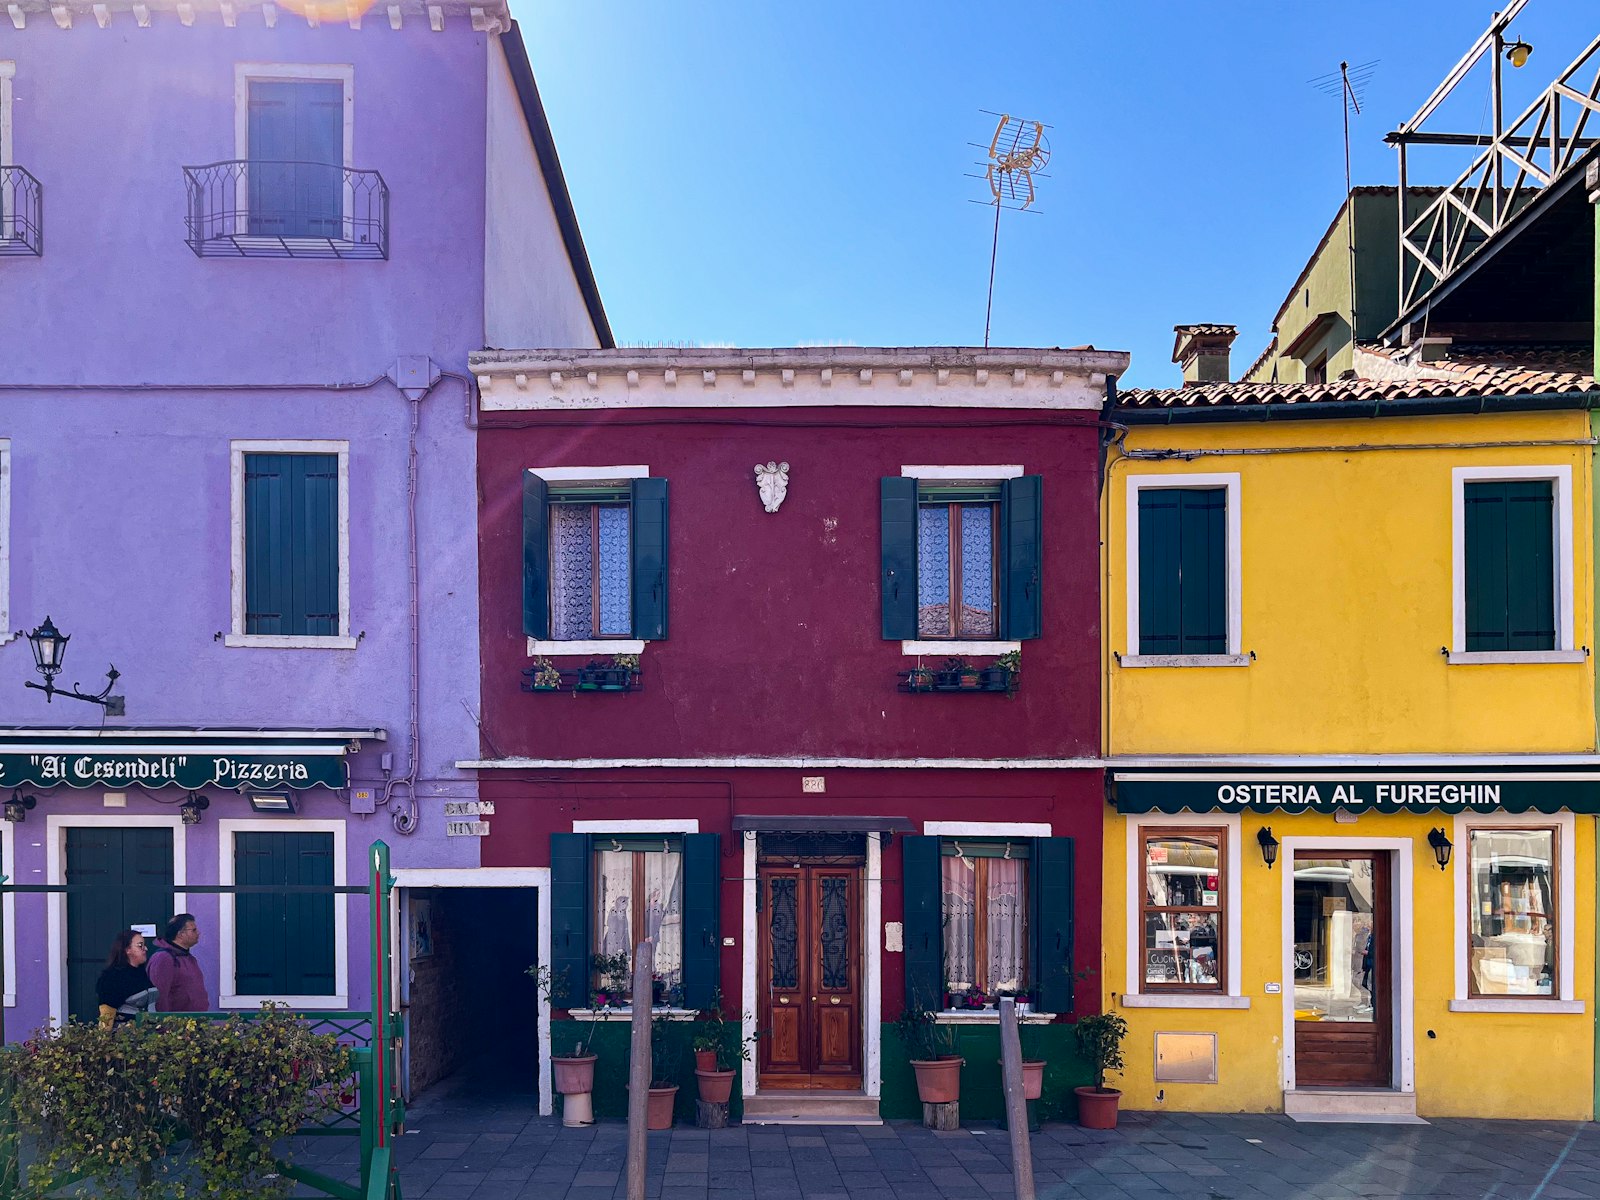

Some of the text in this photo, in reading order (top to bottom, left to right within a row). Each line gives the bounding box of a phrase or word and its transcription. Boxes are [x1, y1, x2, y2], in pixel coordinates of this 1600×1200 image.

[212, 757, 309, 783] Pizzeria
[1217, 784, 1501, 804] OSTERIA AL FUREGHIN
